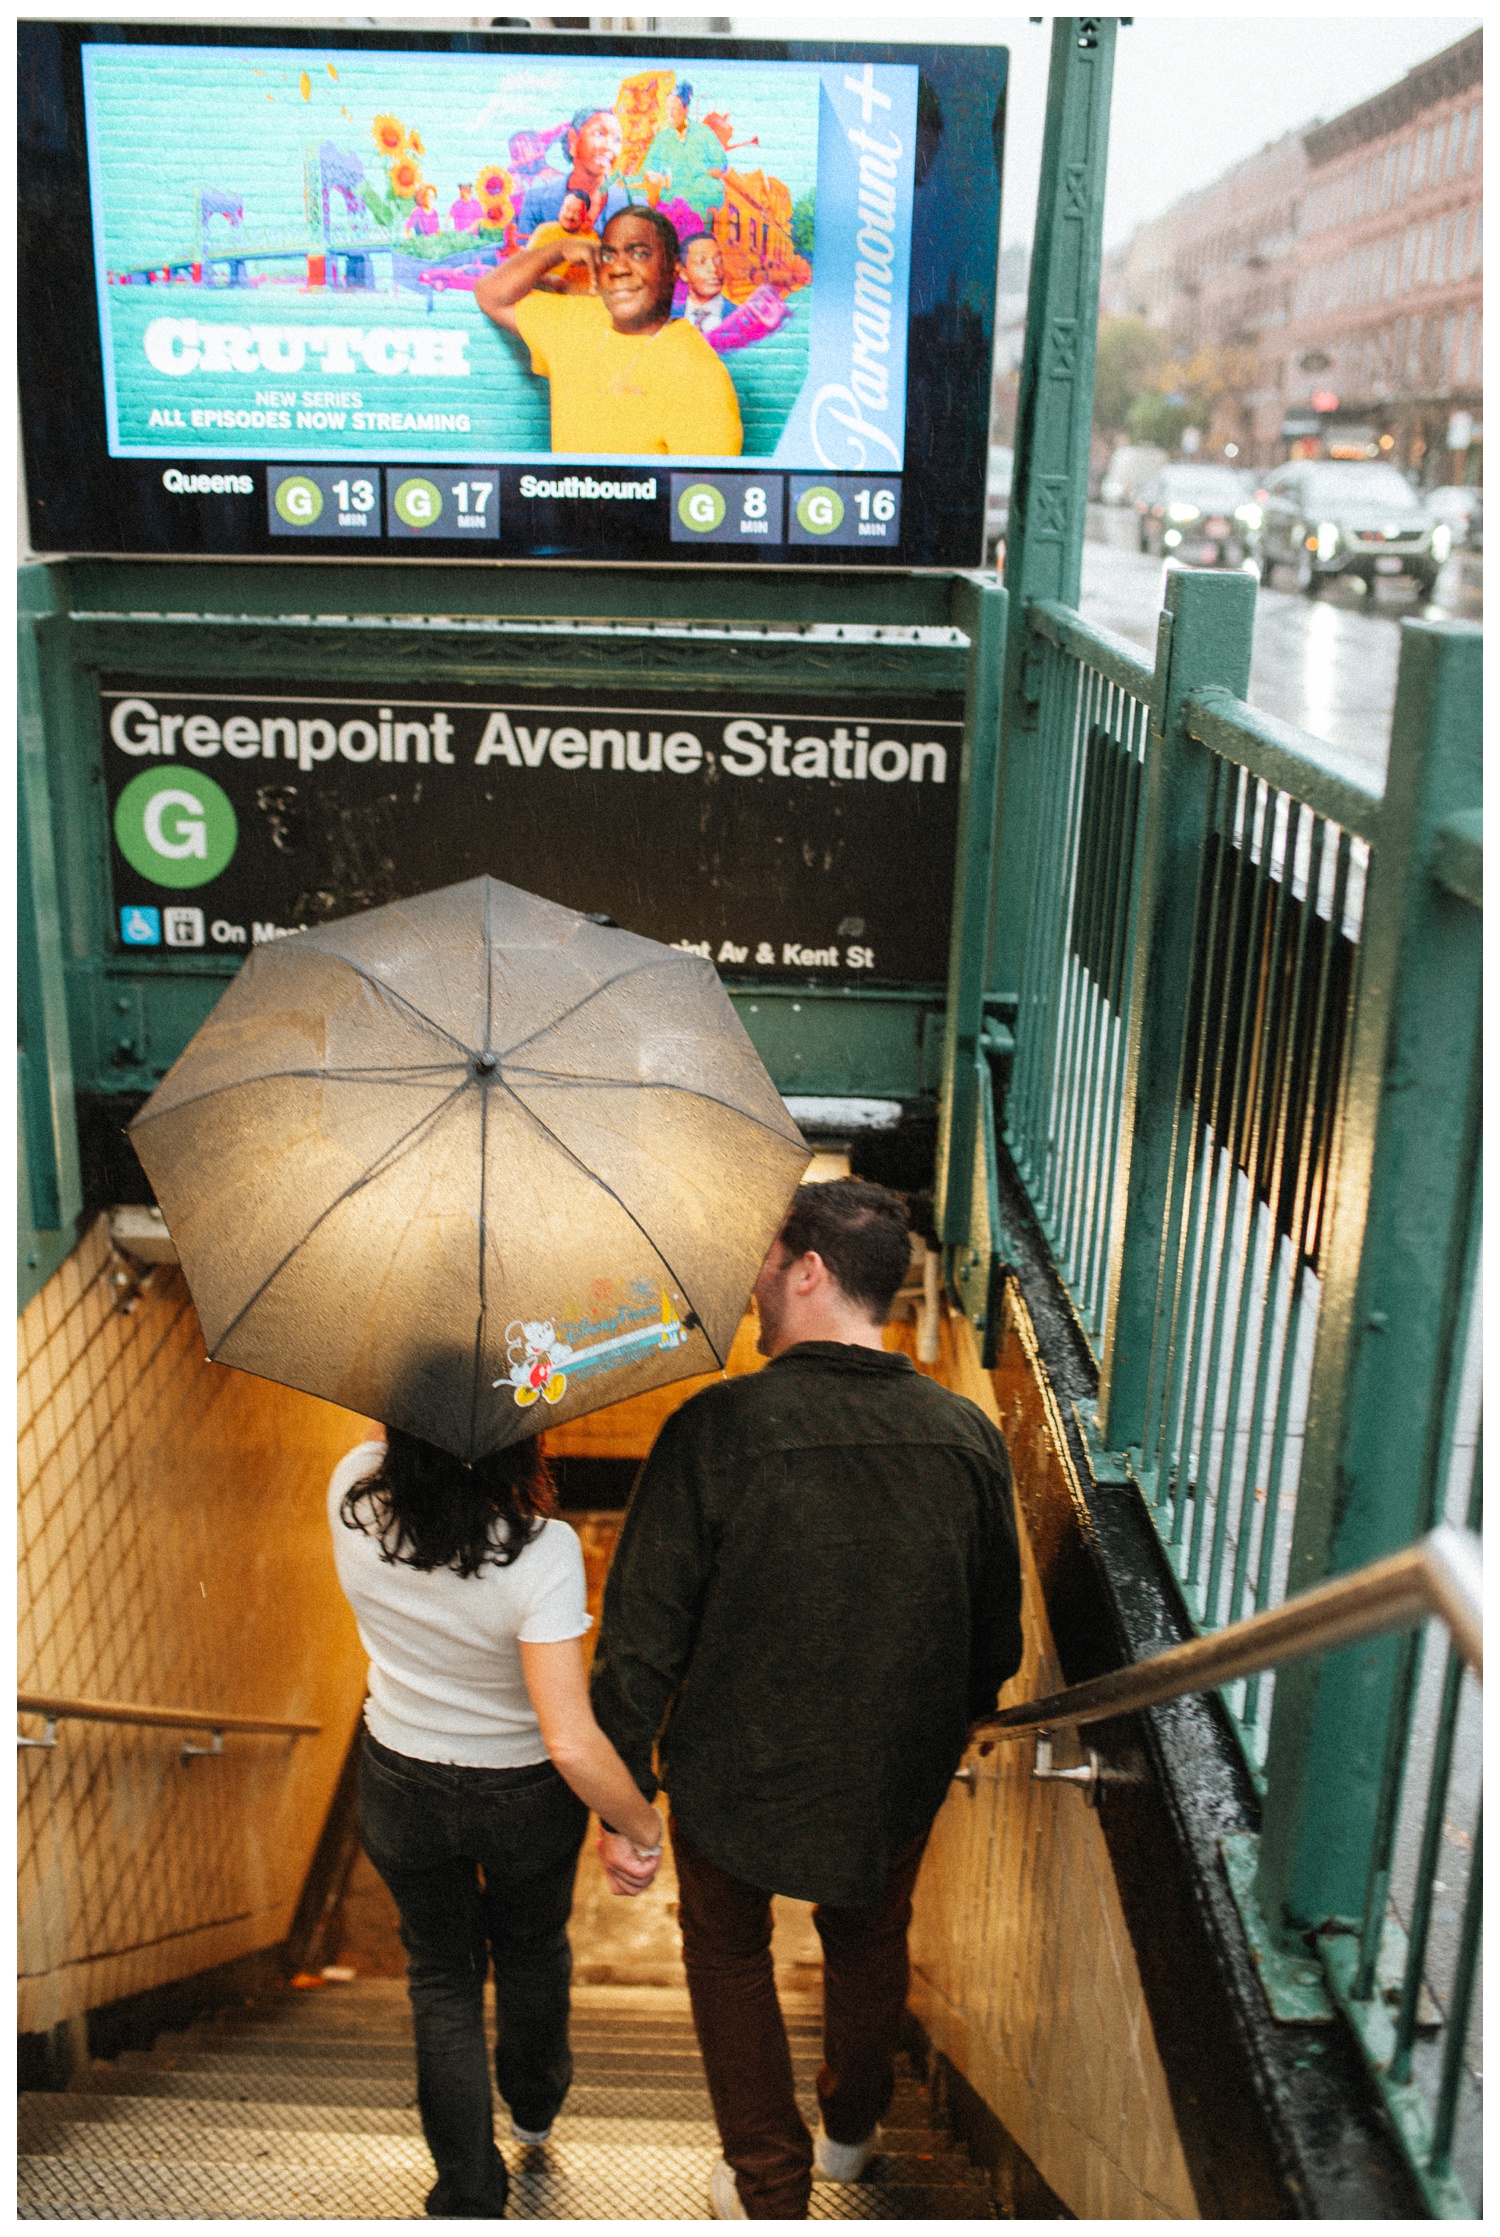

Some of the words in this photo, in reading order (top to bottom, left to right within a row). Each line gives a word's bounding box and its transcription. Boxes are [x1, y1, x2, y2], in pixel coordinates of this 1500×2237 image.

[810, 63, 903, 470] Paramount+
[143, 317, 471, 376] CRUTCH
[255, 391, 297, 408] NEW
[301, 392, 363, 409] SERIES
[149, 409, 187, 428] ALL
[190, 410, 292, 430] EPISODES
[296, 412, 347, 431] NOW
[352, 412, 471, 433] STREAMING
[162, 468, 254, 494] Queens
[519, 475, 657, 500] Southbound
[286, 486, 313, 516] G
[332, 480, 375, 512] 13
[405, 488, 432, 518] G
[451, 482, 493, 513] 17
[688, 493, 715, 522] G
[743, 487, 767, 518] 8
[807, 496, 833, 525] G
[854, 490, 896, 522] 16
[338, 513, 367, 527] MIN
[457, 515, 486, 529] MIN
[740, 520, 769, 534] MIN
[858, 522, 887, 536] MIN
[110, 699, 455, 771] Greenpoint
[474, 712, 702, 774] Avenue
[721, 720, 948, 783] Station
[143, 789, 208, 860] G
[211, 920, 247, 944] On
[717, 940, 749, 963] Av
[756, 942, 776, 965] &
[783, 943, 839, 967] Kent
[846, 946, 875, 968] St
